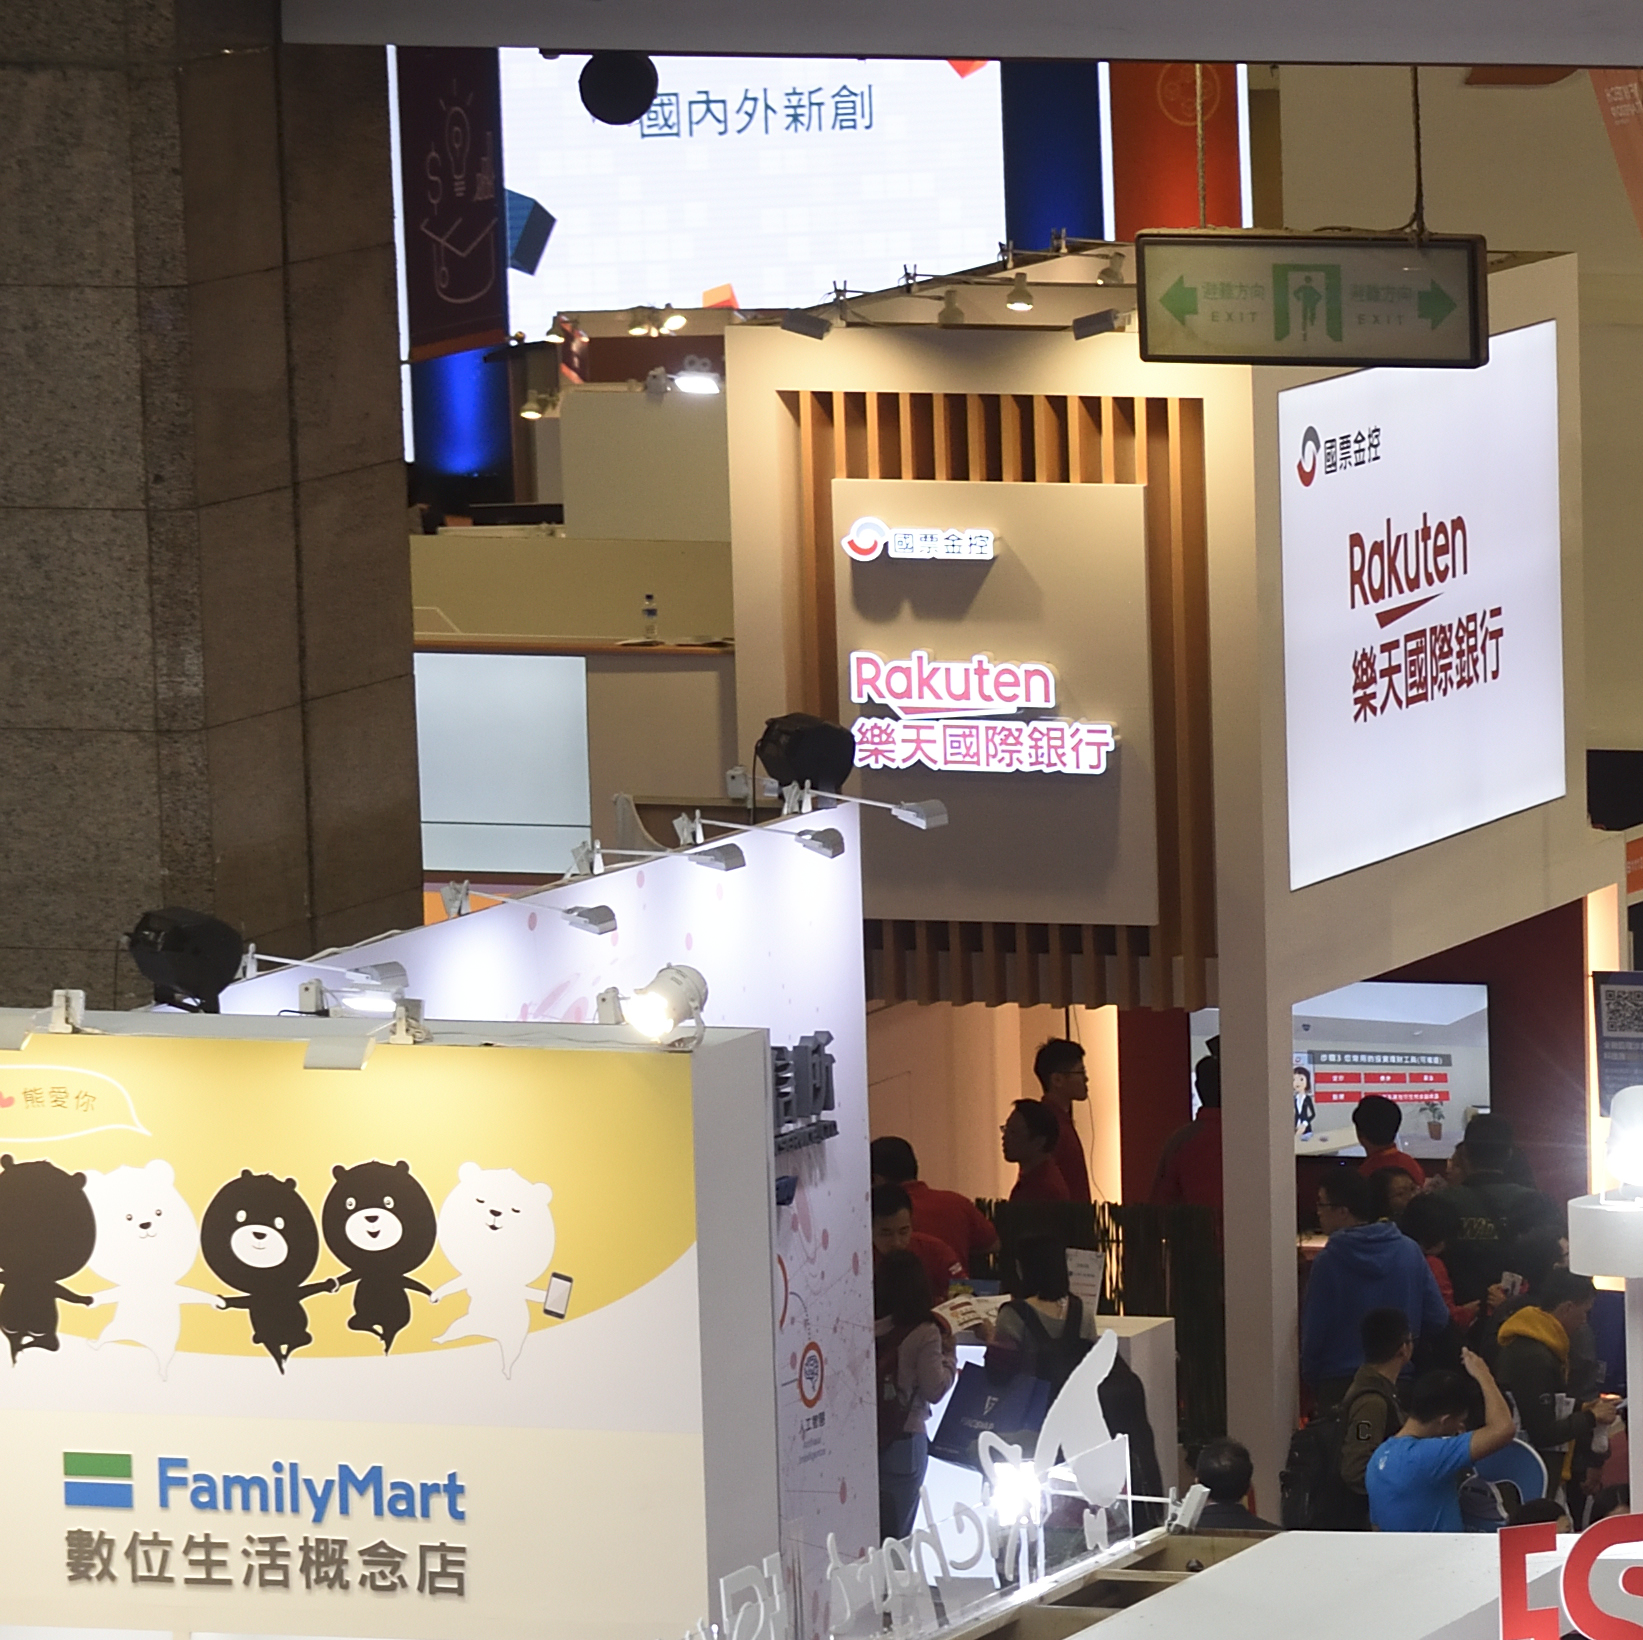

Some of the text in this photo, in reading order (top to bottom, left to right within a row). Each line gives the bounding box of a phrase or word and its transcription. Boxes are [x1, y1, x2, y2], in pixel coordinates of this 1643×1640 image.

[1210, 310, 1259, 324] EXIT
[1323, 424, 1382, 476] 國票金控
[891, 530, 992, 558] 國票金控
[1348, 510, 1469, 611] Rakuten
[854, 654, 1054, 704] Rakuten
[1351, 605, 1505, 725] 樂天國際銀行
[855, 722, 1113, 772] 樂天國際銀行
[21, 1086, 98, 1115] 熊愛你
[157, 1455, 467, 1524] FamilyMart
[64, 1527, 469, 1598] 數位生活概念店
